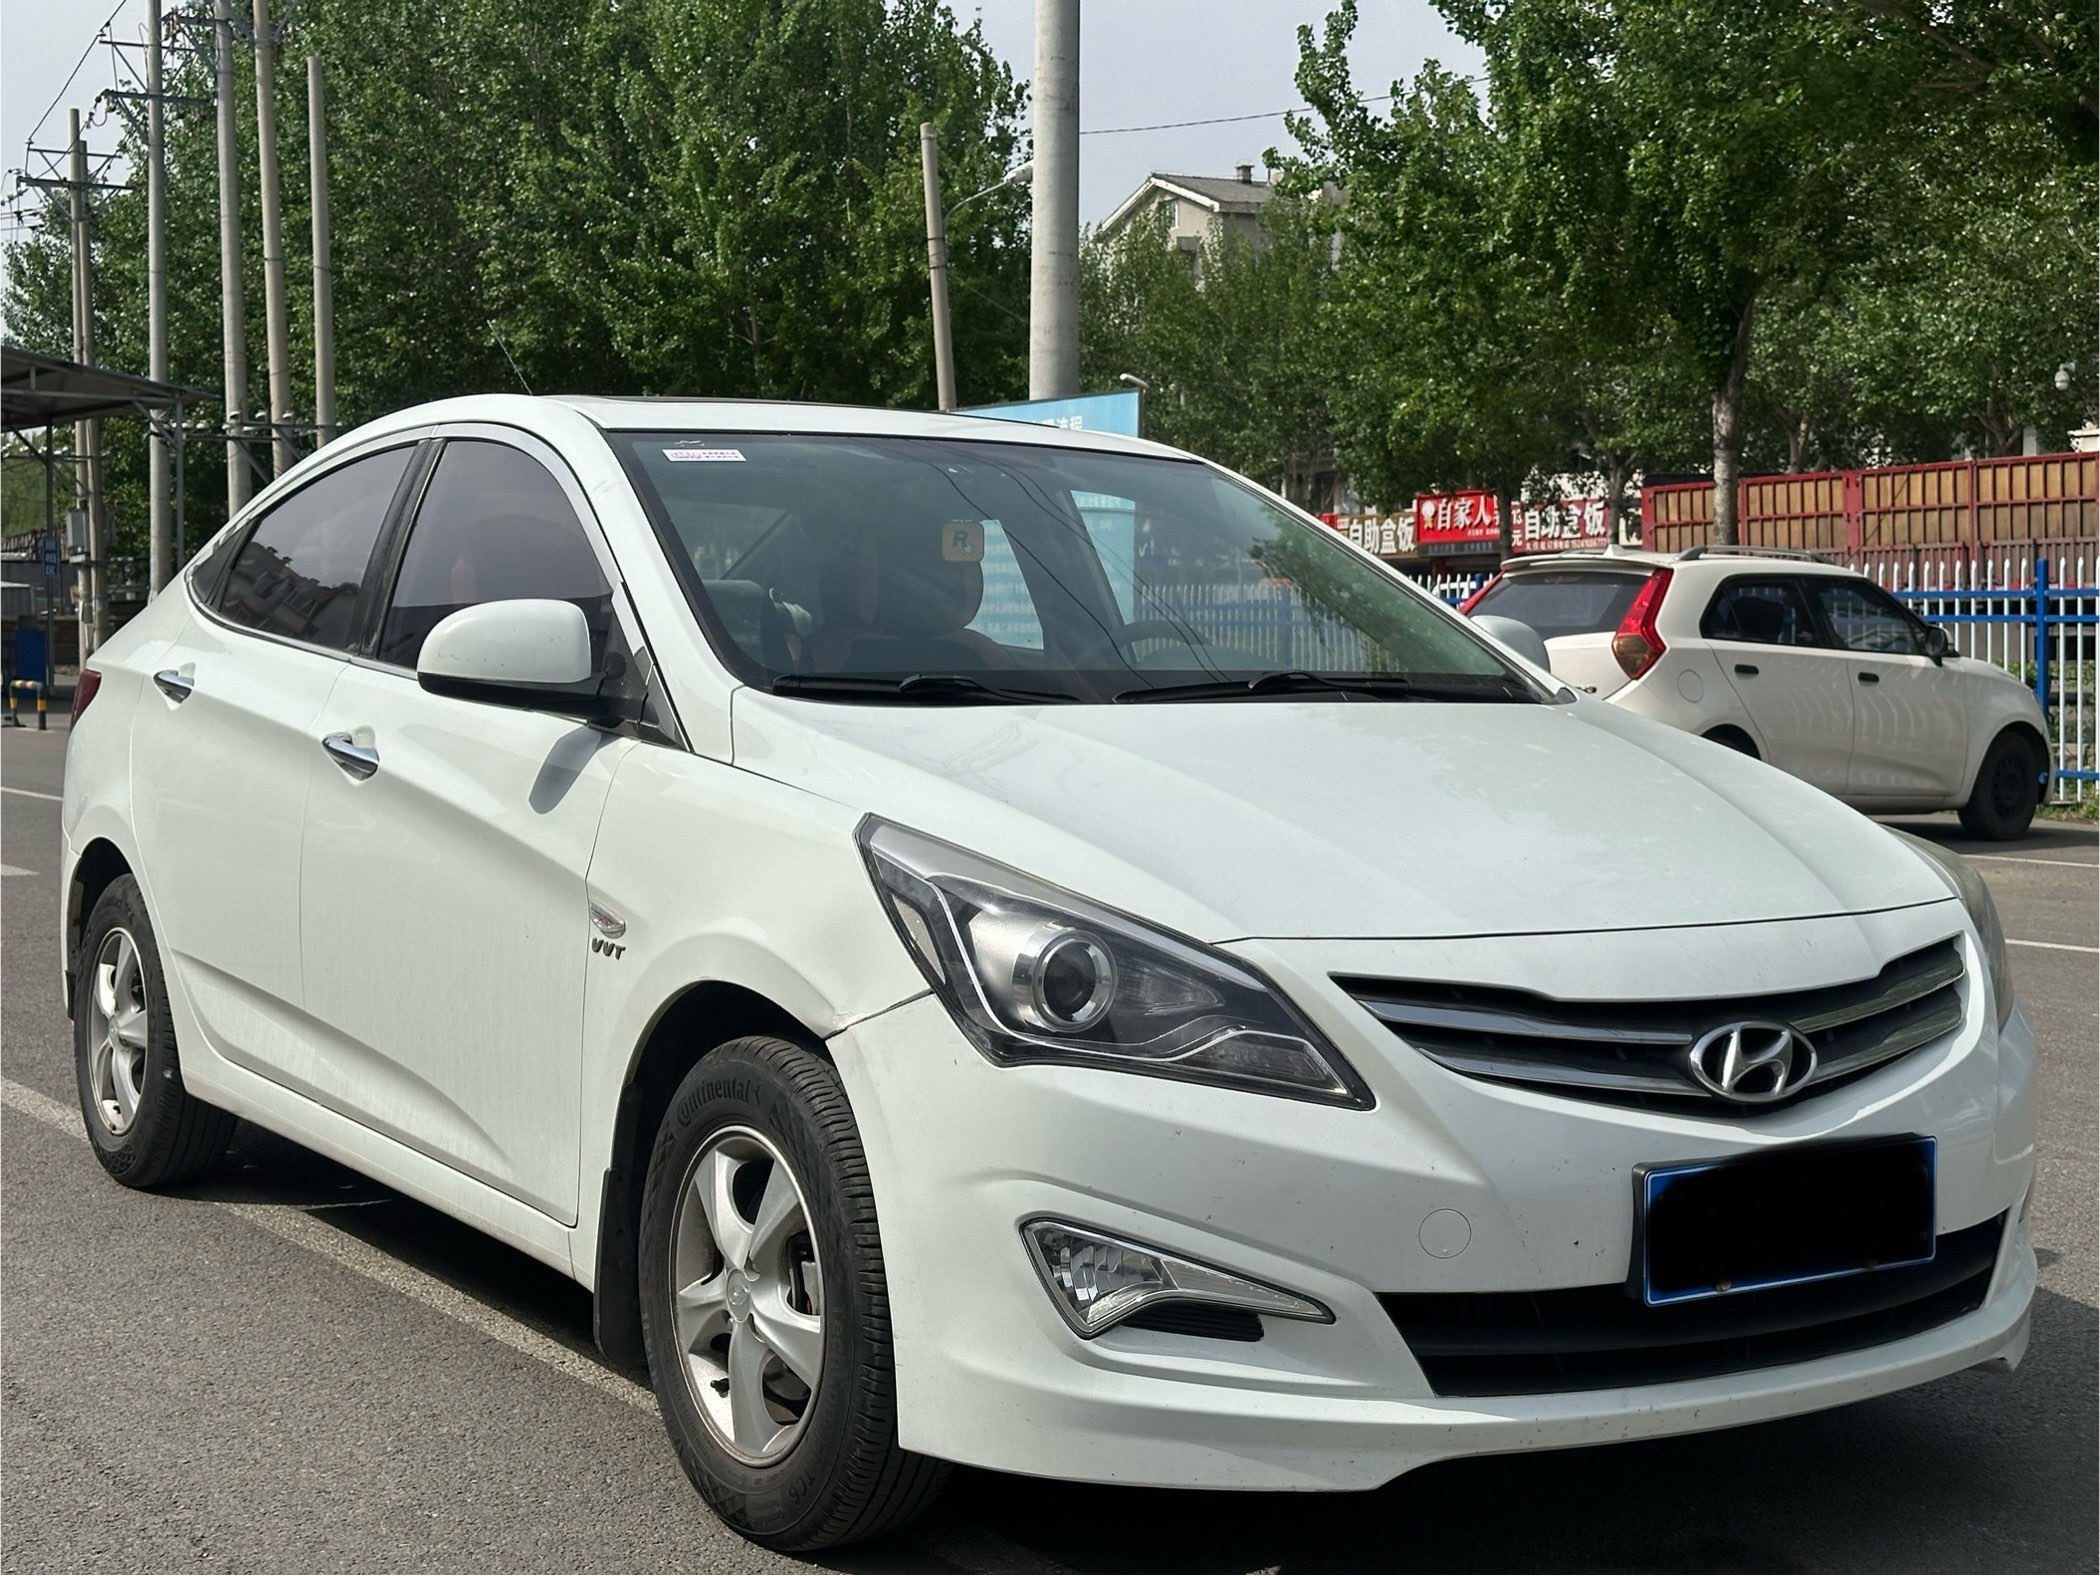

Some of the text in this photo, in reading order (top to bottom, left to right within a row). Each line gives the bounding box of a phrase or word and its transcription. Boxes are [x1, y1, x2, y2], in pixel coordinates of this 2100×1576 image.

[1349, 518, 1416, 554] 自助盒饭
[677, 1076, 752, 1127] Continental
